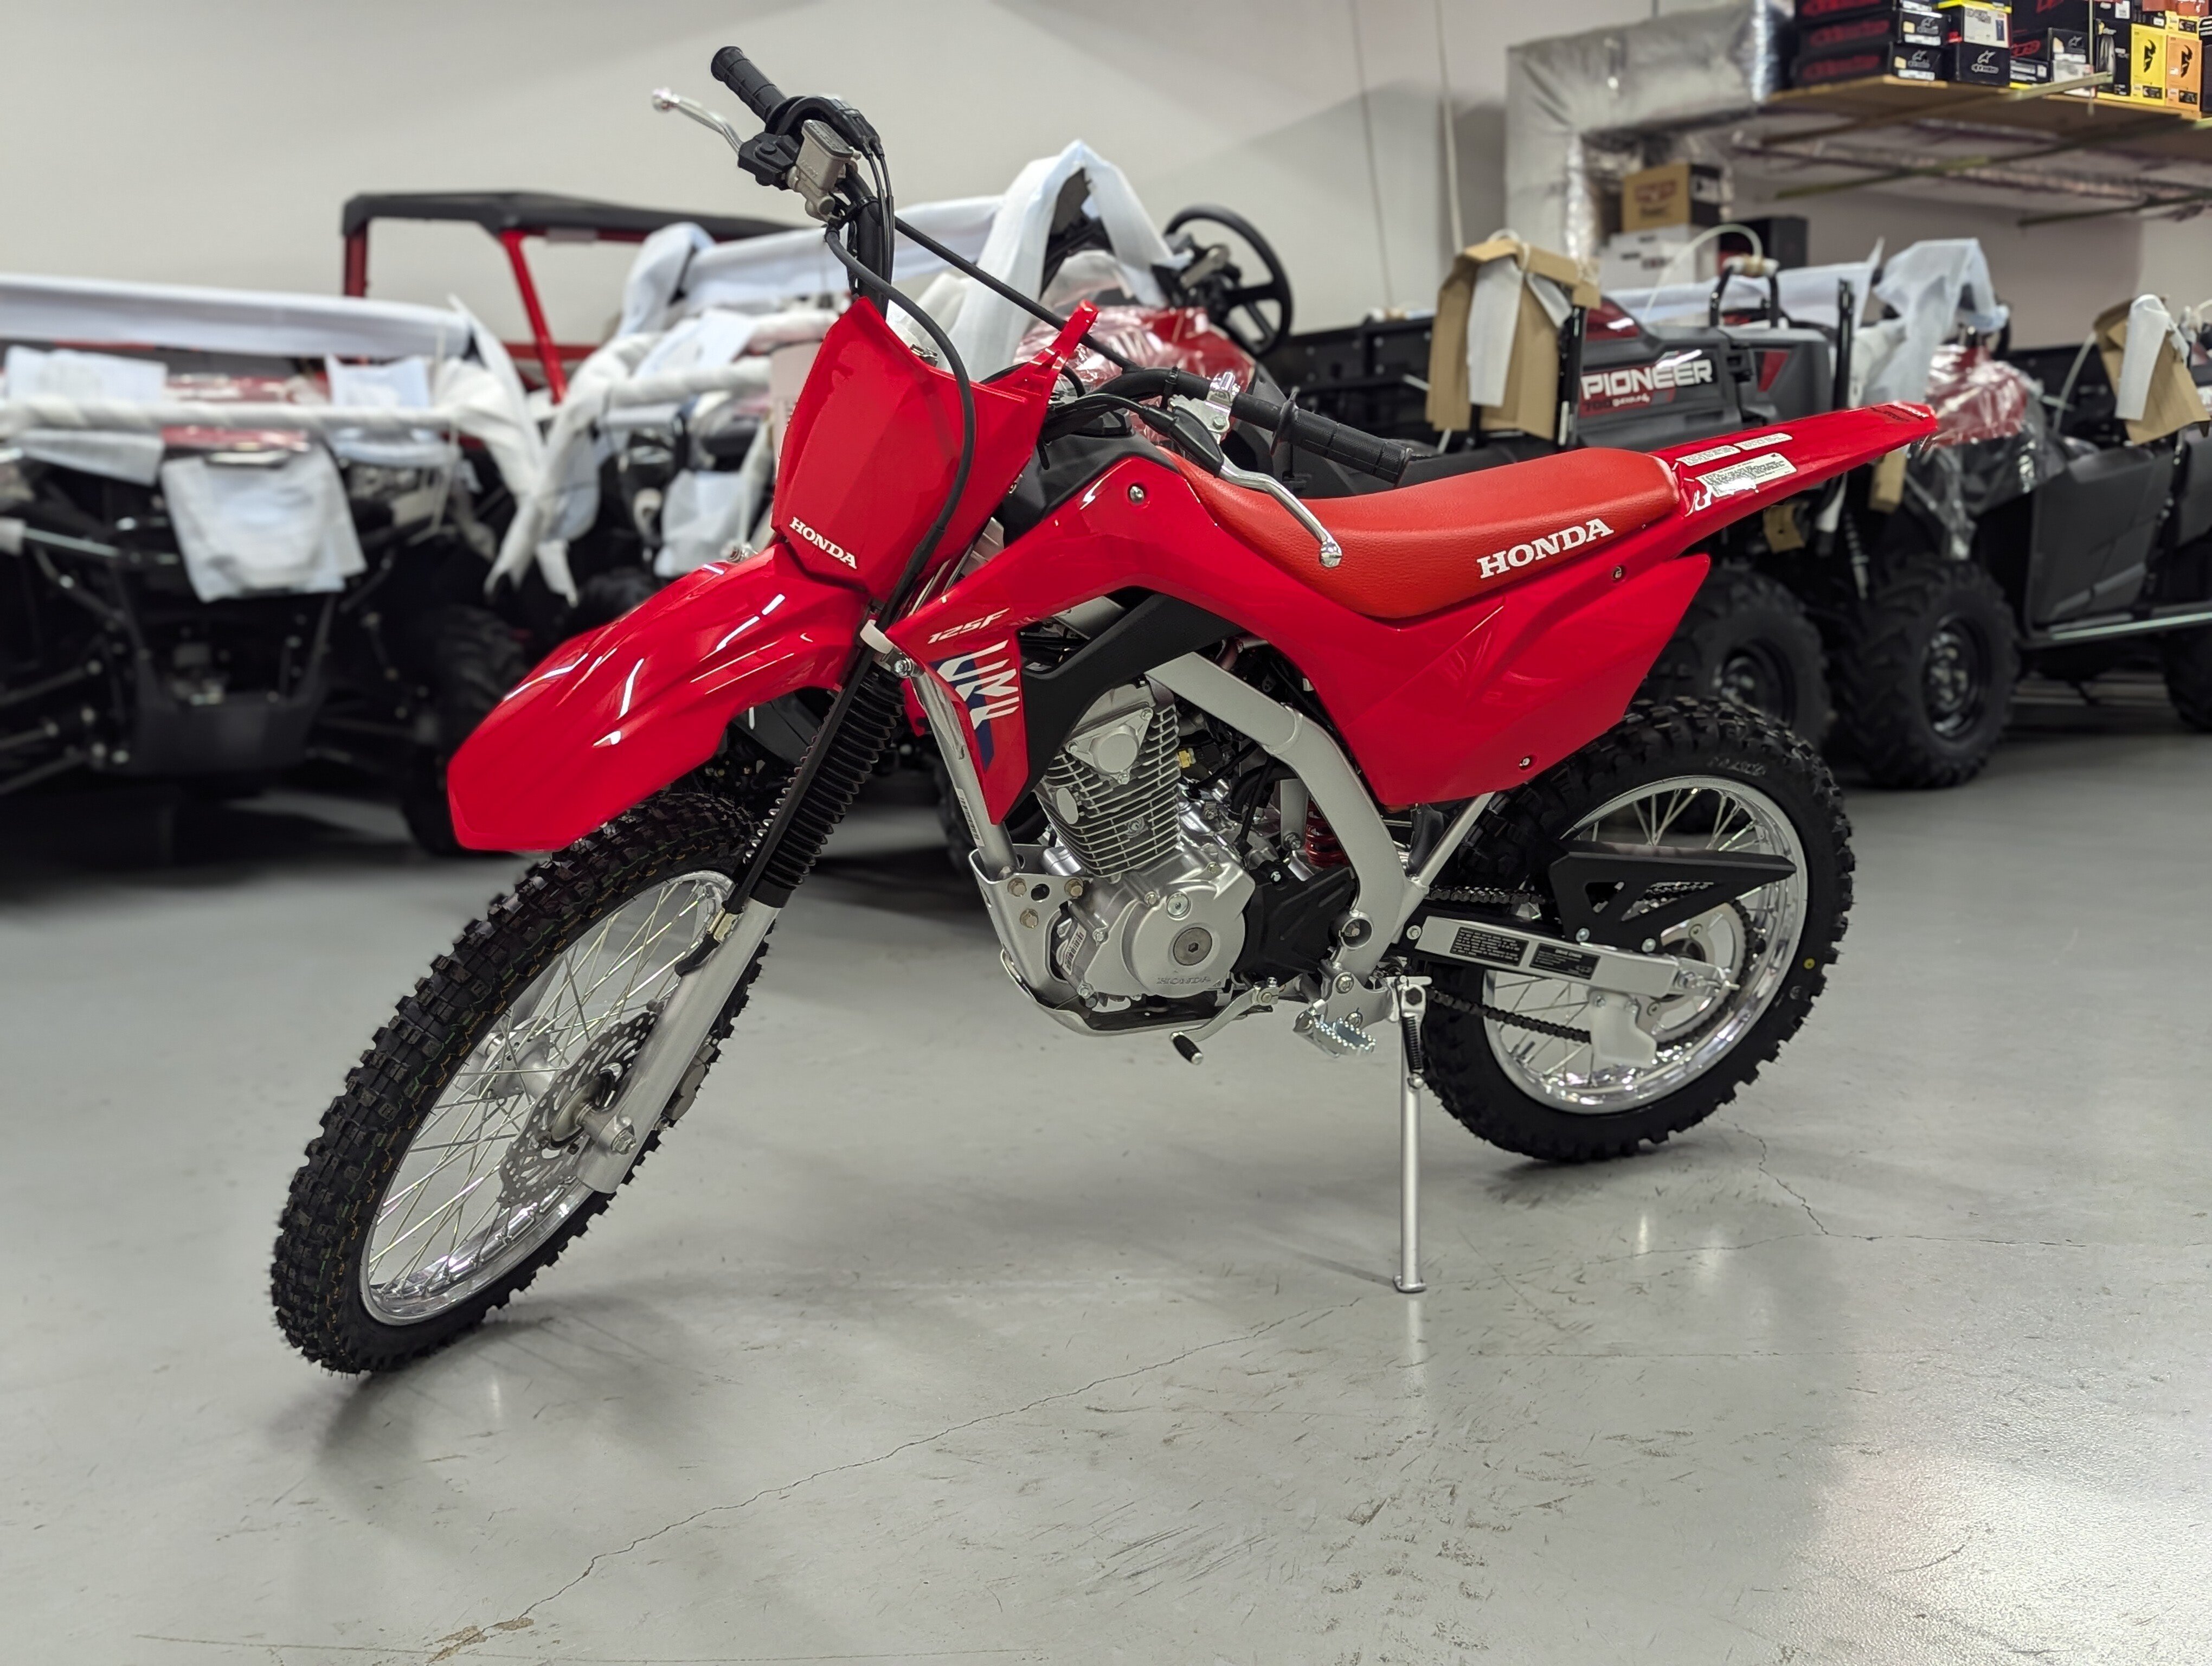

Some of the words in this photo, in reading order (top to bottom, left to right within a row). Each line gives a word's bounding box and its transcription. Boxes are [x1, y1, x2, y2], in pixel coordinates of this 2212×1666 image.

[1581, 359, 1713, 400] PIONEER
[789, 516, 857, 569] HONDA
[1477, 518, 1614, 579] HONDA
[928, 607, 1010, 644] 125F
